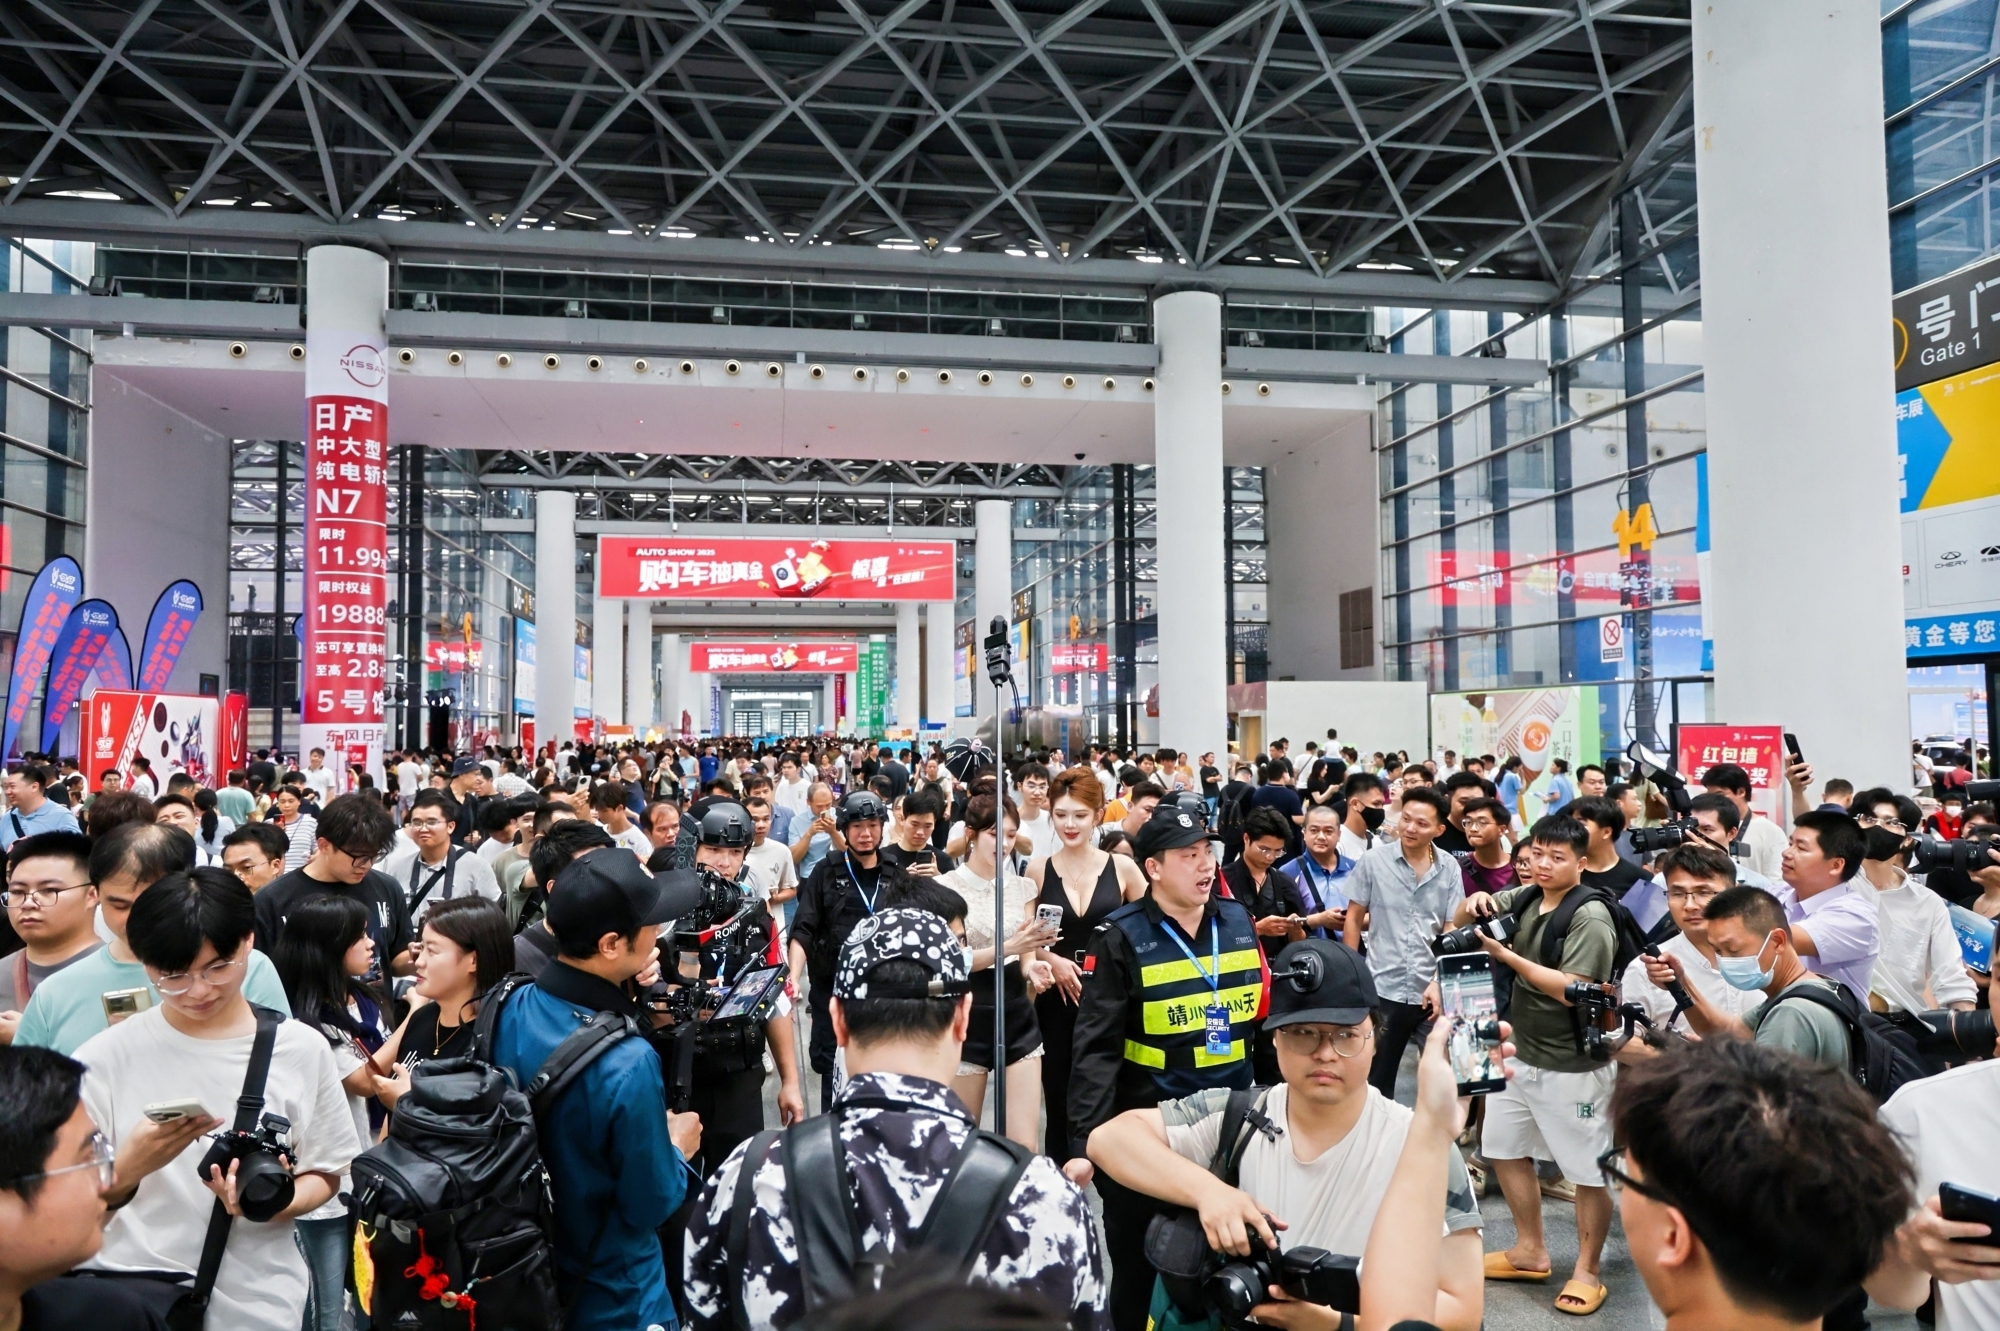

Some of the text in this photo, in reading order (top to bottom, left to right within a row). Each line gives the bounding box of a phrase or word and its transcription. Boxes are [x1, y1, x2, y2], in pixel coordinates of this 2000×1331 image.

[1920, 331, 1980, 366] Gate 1
[340, 357, 386, 375] NISSAN
[316, 403, 373, 432] 日产
[316, 436, 381, 460] 中大型
[316, 488, 362, 515] N7
[319, 527, 346, 540] 限时
[1612, 503, 1657, 557] 14
[638, 559, 763, 592] 购车抽真金
[852, 556, 889, 579] 惊喜
[1934, 559, 1968, 569] CHERY
[318, 581, 372, 595] 限时权益
[317, 604, 385, 626] 19888
[1637, 559, 1652, 651] EXHIBTION
[1904, 619, 2000, 648] 黄金等您
[315, 664, 342, 677] 至高
[317, 690, 384, 715] 5号馆
[1702, 746, 1759, 764] 红包墙
[1693, 765, 1769, 786] 幸奖
[715, 919, 741, 940] RONIN
[1167, 992, 1255, 1027] 靖 JINAN 天
